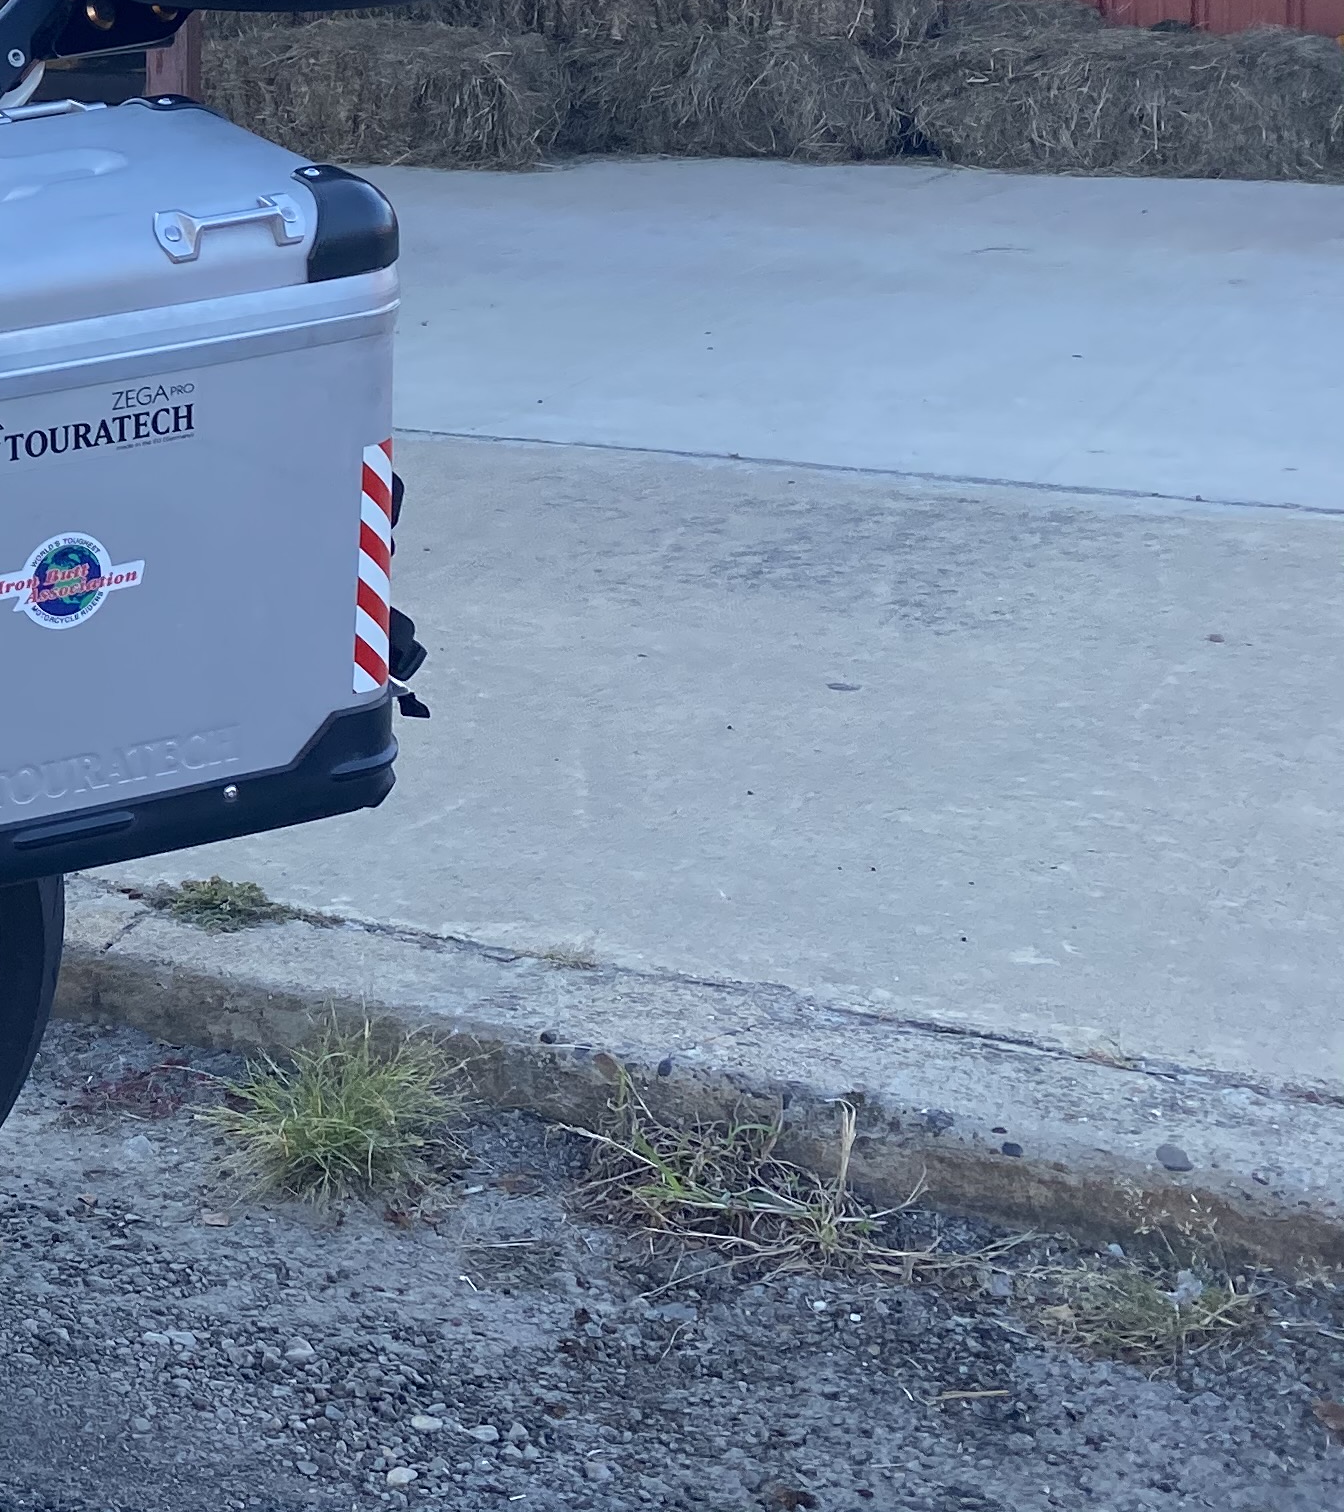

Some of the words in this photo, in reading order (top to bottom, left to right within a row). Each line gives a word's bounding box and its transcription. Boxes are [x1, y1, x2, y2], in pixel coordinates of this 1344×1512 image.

[112, 384, 169, 411] ZEGA
[170, 382, 195, 396] PRO
[4, 403, 195, 462] TOURATECH
[63, 538, 101, 555] TOUGHEST
[24, 569, 138, 605] Association
[43, 562, 91, 586] Butt
[31, 605, 80, 624] MOTORCYCLE
[80, 591, 104, 616] RIDERS
